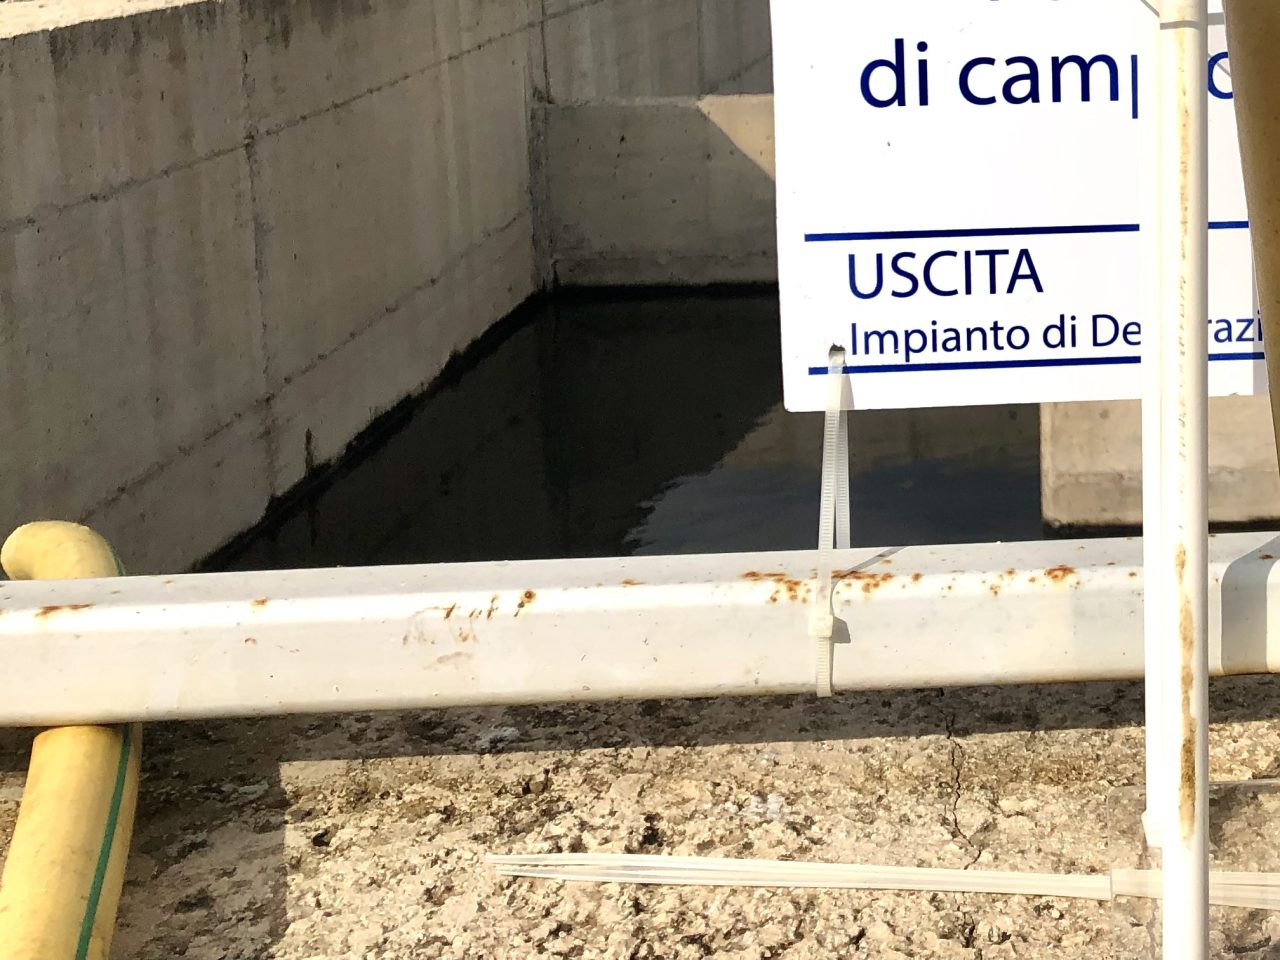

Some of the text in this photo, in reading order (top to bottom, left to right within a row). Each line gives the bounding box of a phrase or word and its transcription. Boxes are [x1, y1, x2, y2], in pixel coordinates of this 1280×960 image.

[860, 38, 929, 108] di
[848, 248, 1044, 299] USCITA
[851, 320, 1030, 363] Impianto
[1042, 314, 1077, 348] di
